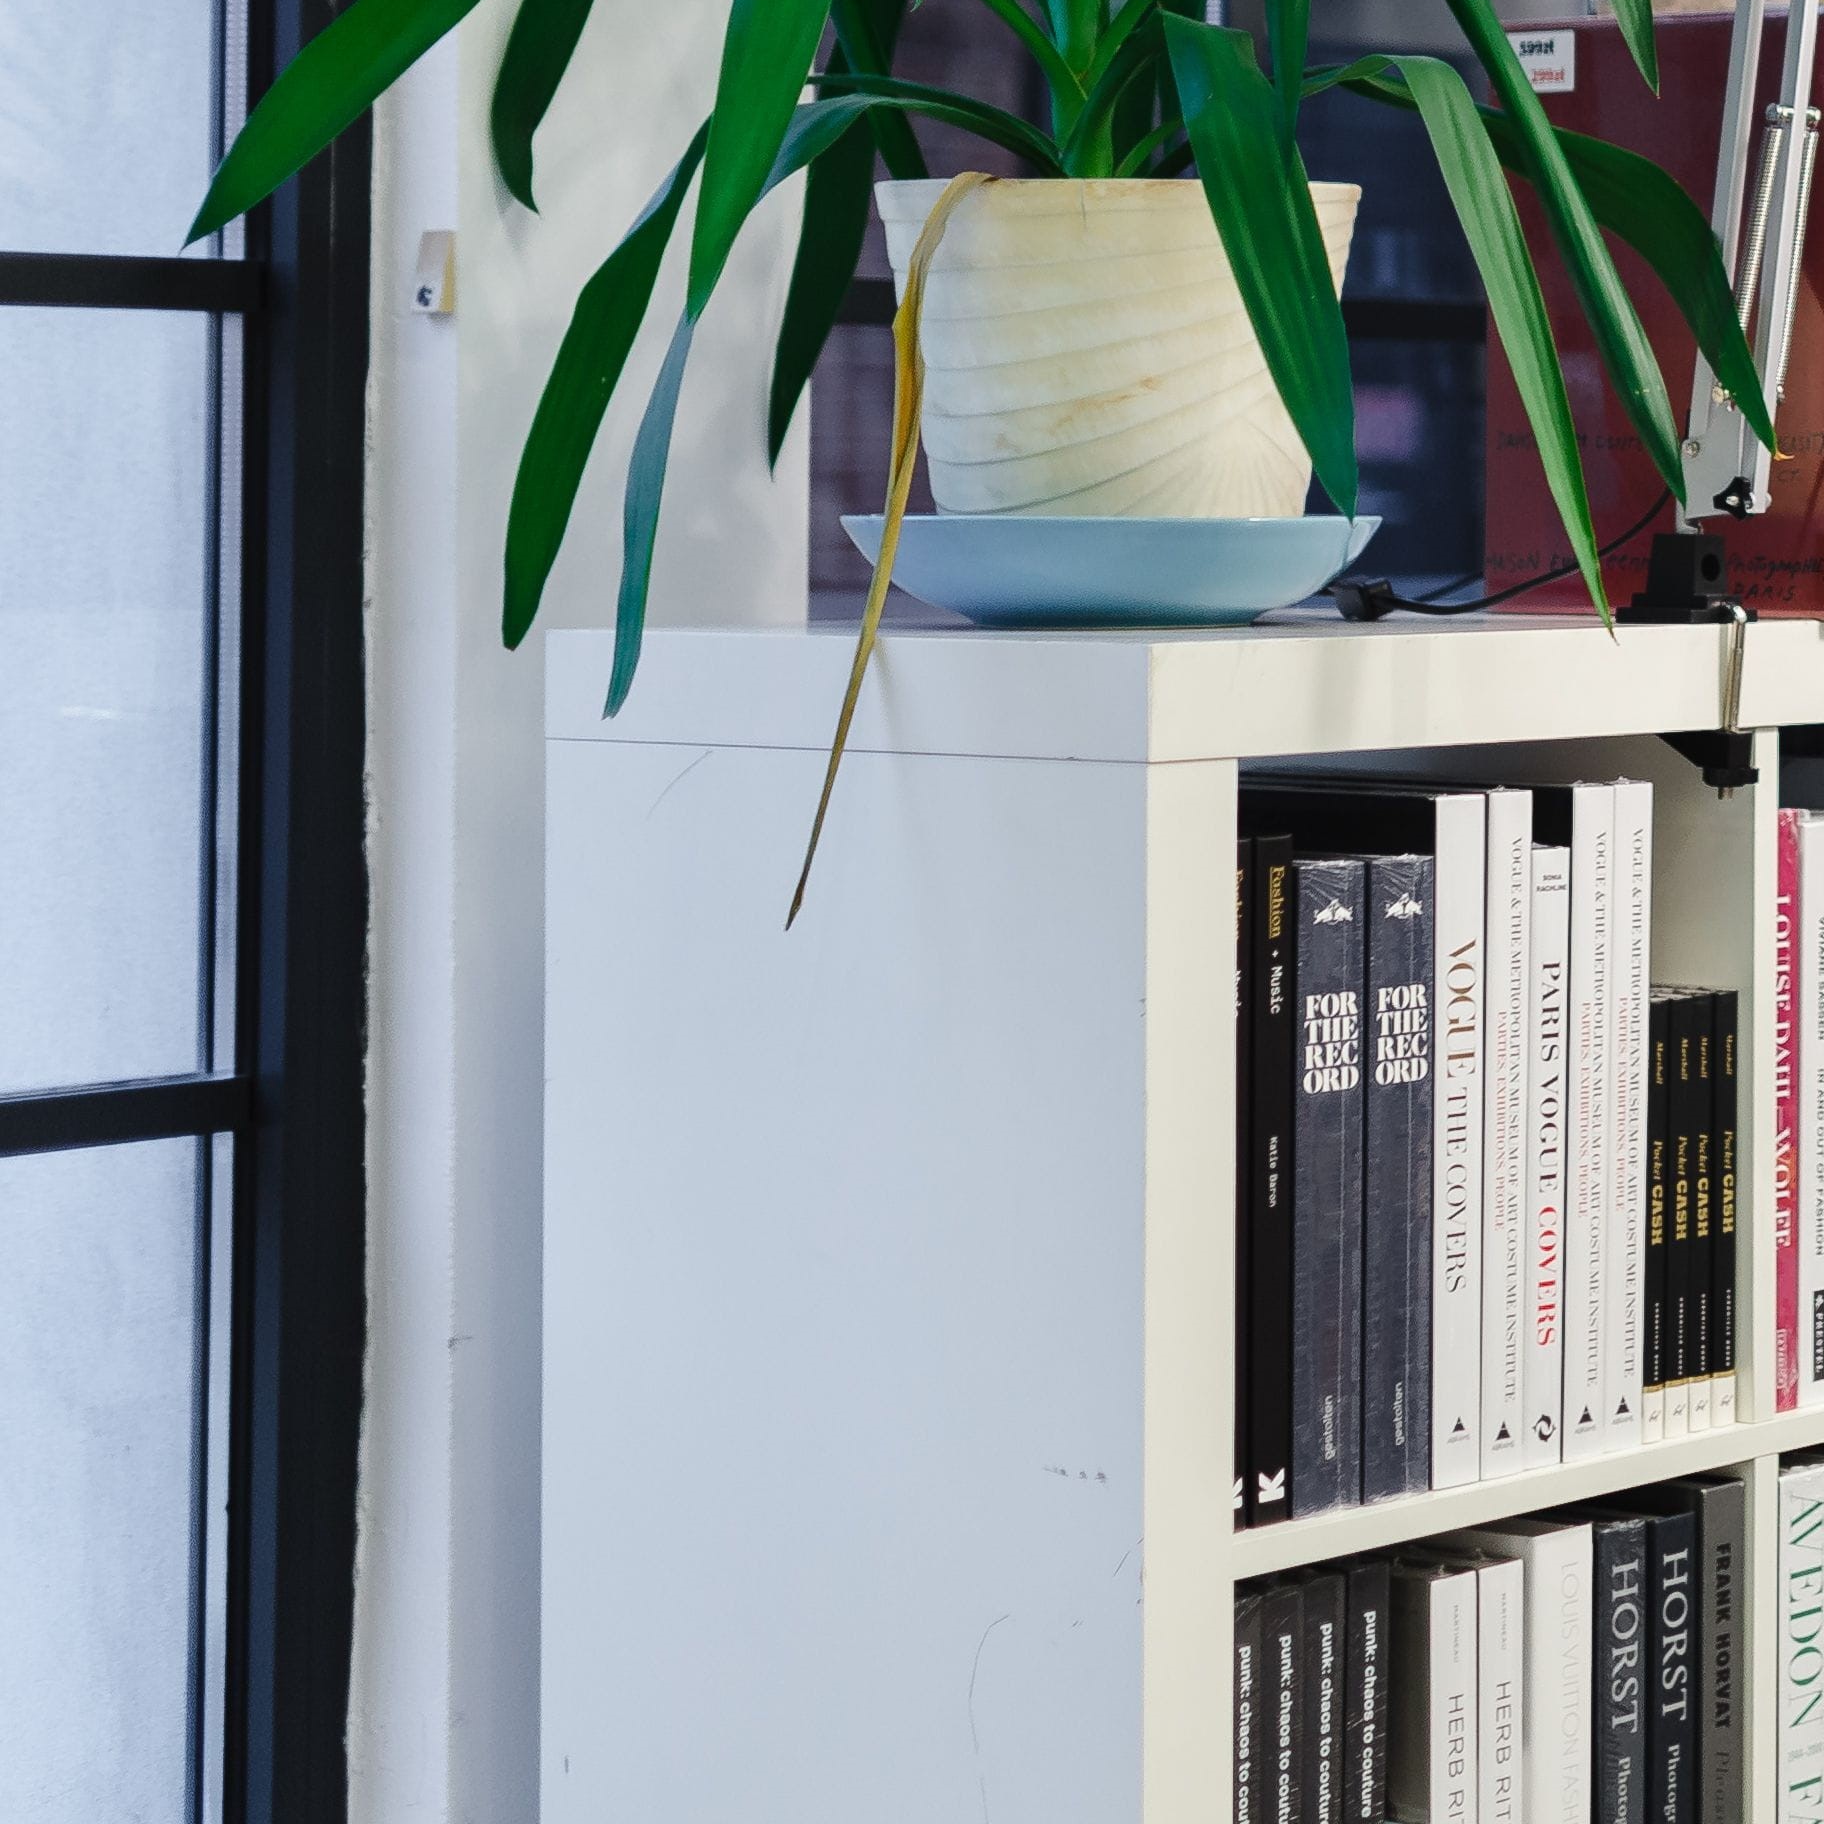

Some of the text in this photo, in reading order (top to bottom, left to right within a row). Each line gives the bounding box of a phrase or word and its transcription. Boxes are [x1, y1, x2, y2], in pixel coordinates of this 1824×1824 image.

[1511, 838, 1522, 894] VOGUE
[1595, 832, 1606, 886] VOGUE
[1632, 828, 1644, 881] VOGUE
[1268, 866, 1287, 1014] Fashion Music
[1511, 912, 1521, 946] THE
[1595, 904, 1605, 938] THE
[1632, 899, 1642, 933] THE
[1303, 991, 1359, 1019] FOR
[1303, 1015, 1359, 1046] THE
[1376, 1008, 1428, 1036] THE
[1377, 984, 1428, 1012] FOR
[1509, 952, 1521, 1084] METROPOLITAN
[1593, 943, 1605, 1074] METROPOLITAN
[1630, 938, 1641, 1067] METROPOLITAN
[1303, 1040, 1359, 1070] REC
[1303, 1065, 1360, 1095] ORD
[1374, 1056, 1429, 1086] ORD
[1375, 1031, 1428, 1061] REC
[1446, 939, 1477, 1293] VOGUE THE COVERS
[1508, 1088, 1519, 1160] MUSEUM
[1592, 1078, 1603, 1151] MUSEUM
[1628, 1071, 1639, 1144] MUSEUM
[1269, 1136, 1280, 1168] Katie
[1537, 962, 1561, 1346] PARIS VOGUE COVERS
[1615, 1158, 1626, 1211] PEOPLE
[1675, 1136, 1688, 1240] Pocket CASH
[1697, 1134, 1709, 1237] Pocket CASH
[1722, 1131, 1735, 1233] Pocket CASH
[1494, 1176, 1505, 1231] PEOPLE
[1507, 1194, 1518, 1226] ART
[1578, 1165, 1589, 1218] PEOPLE
[1590, 1182, 1601, 1213] ART
[1626, 1175, 1637, 1206] ART
[1651, 1140, 1664, 1245] Pocket CASH
[1506, 1229, 1517, 1311] COSTUME
[1588, 1216, 1600, 1296] COSTUME
[1625, 1209, 1636, 1288] COSTUME
[1323, 1395, 1337, 1461] gestalten
[1393, 1382, 1406, 1446] gestalten
[1611, 1560, 1639, 1733] HORST
[1662, 1548, 1689, 1720] HORST
[1714, 1542, 1732, 1729] FRANK HORVAT
[1789, 1495, 1824, 1728] AVEDON
[1319, 1623, 1334, 1757] punk: chaos to
[1561, 1561, 1580, 1757] LOUIS VUITTON
[1237, 1645, 1252, 1782] punk: chaos to
[1278, 1635, 1293, 1770] punk: chaos to
[1361, 1610, 1378, 1818] punk: chaos to couture
[1448, 1693, 1465, 1778] HERB
[1495, 1680, 1512, 1764] HERB
